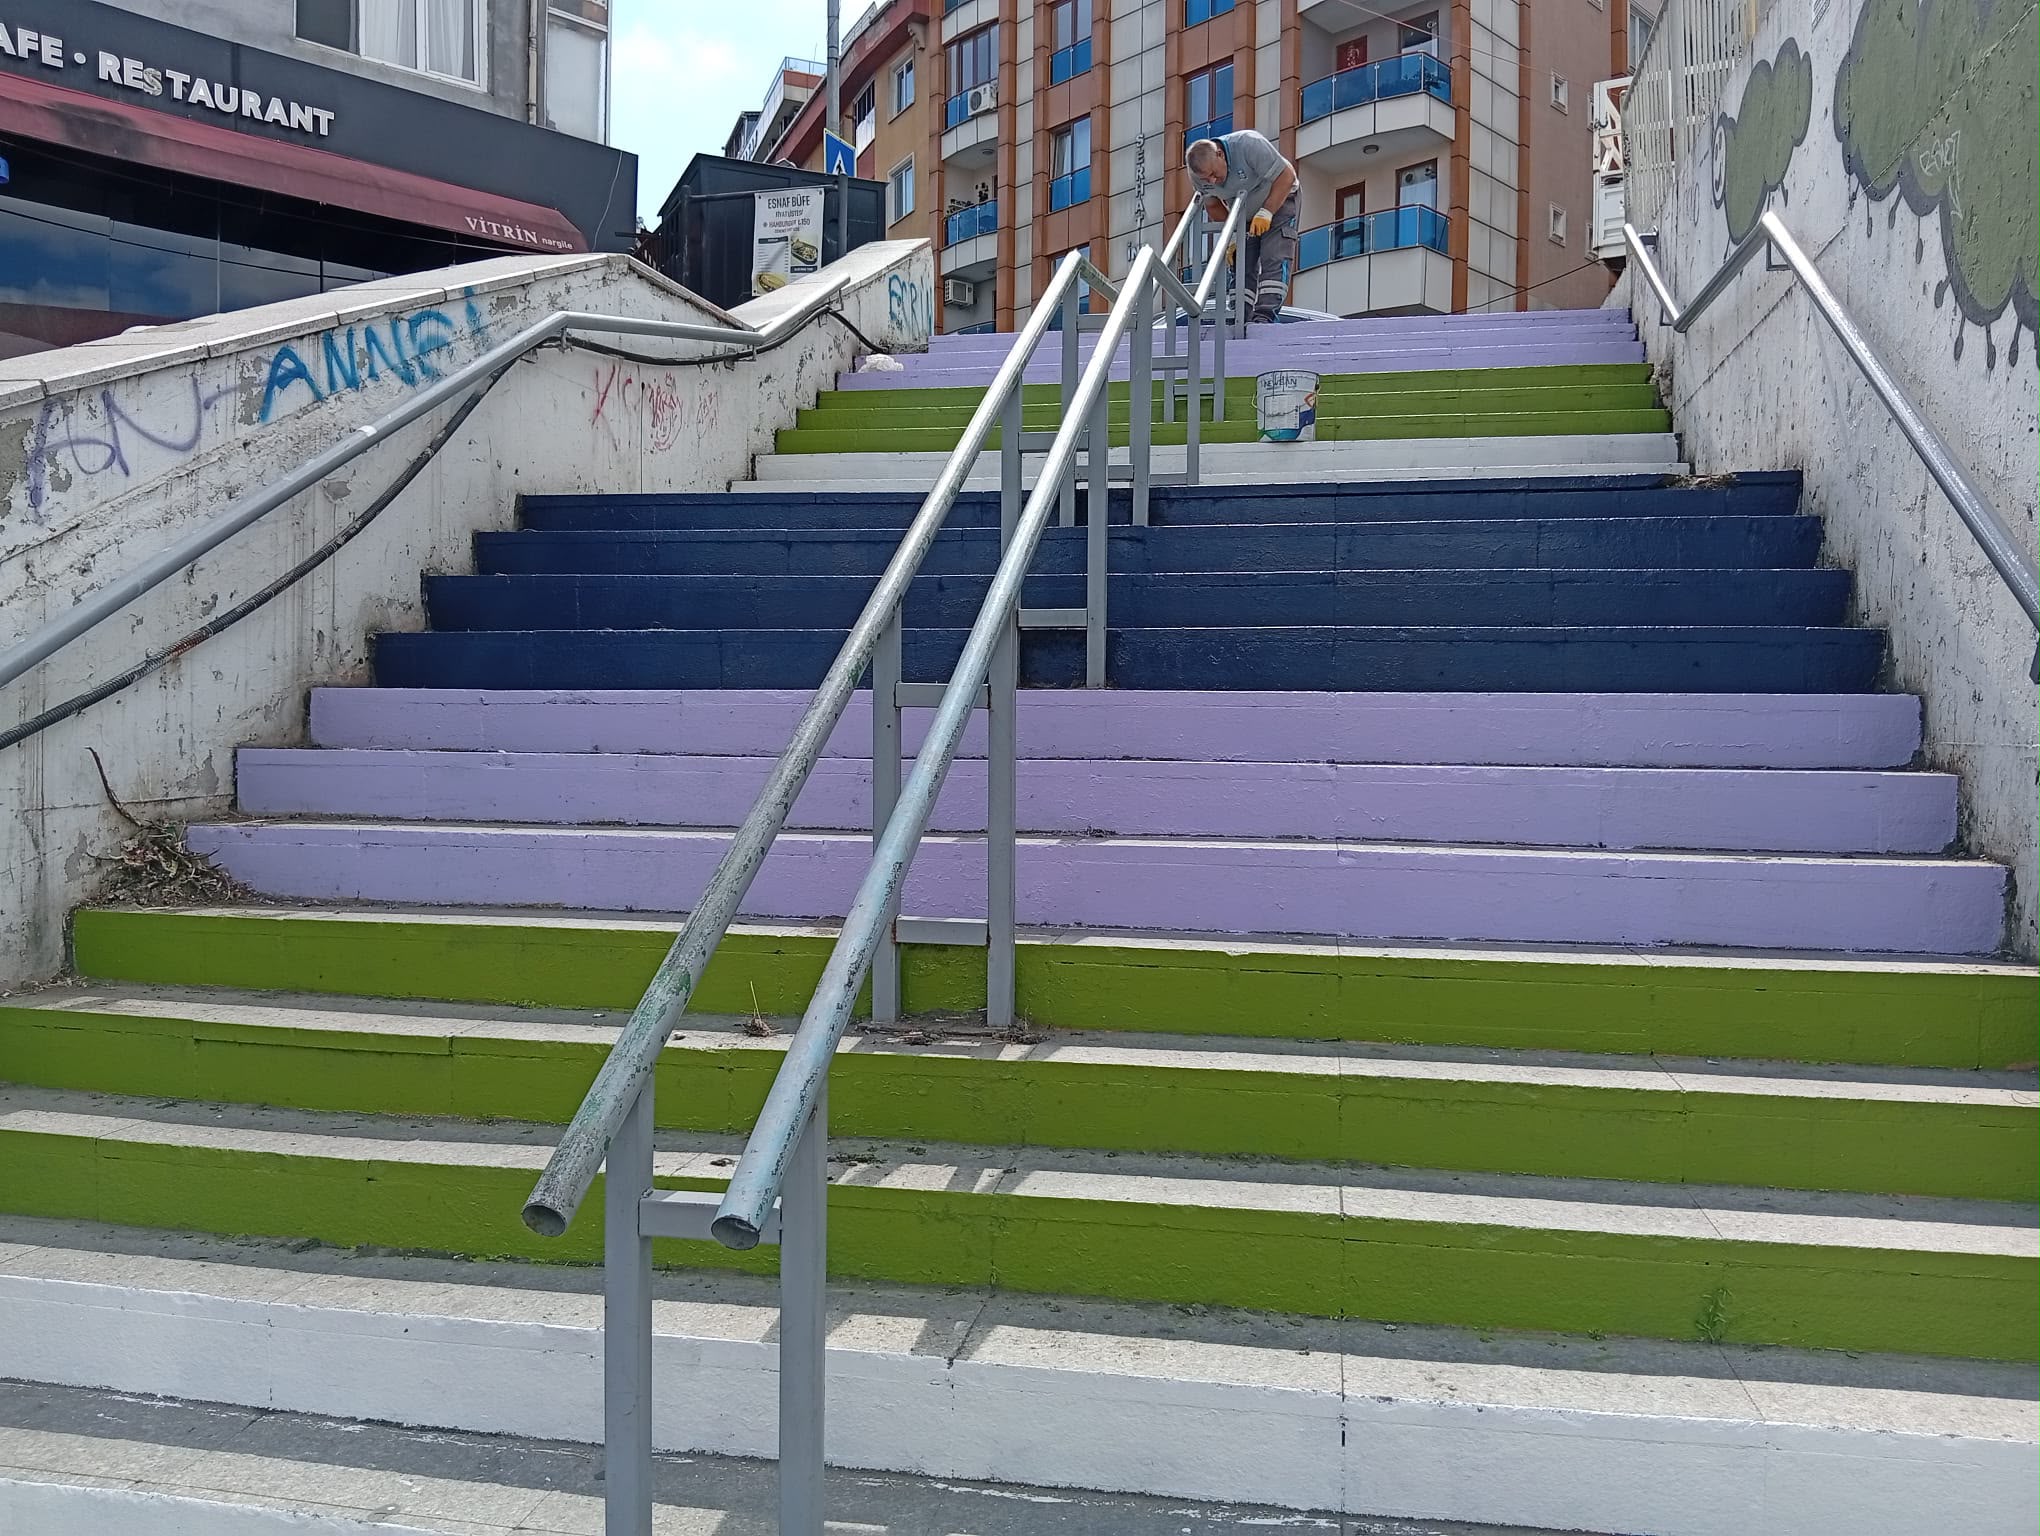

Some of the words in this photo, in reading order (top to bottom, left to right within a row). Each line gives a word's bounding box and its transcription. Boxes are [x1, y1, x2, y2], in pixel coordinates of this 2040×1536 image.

[97, 49, 335, 137] RESTAURANT
[767, 196, 790, 210] ESNAF
[791, 193, 811, 207] BÜFE
[1135, 133, 1146, 231] SERHAT
[464, 215, 539, 245] VİTRİN
[541, 237, 574, 250] nargile
